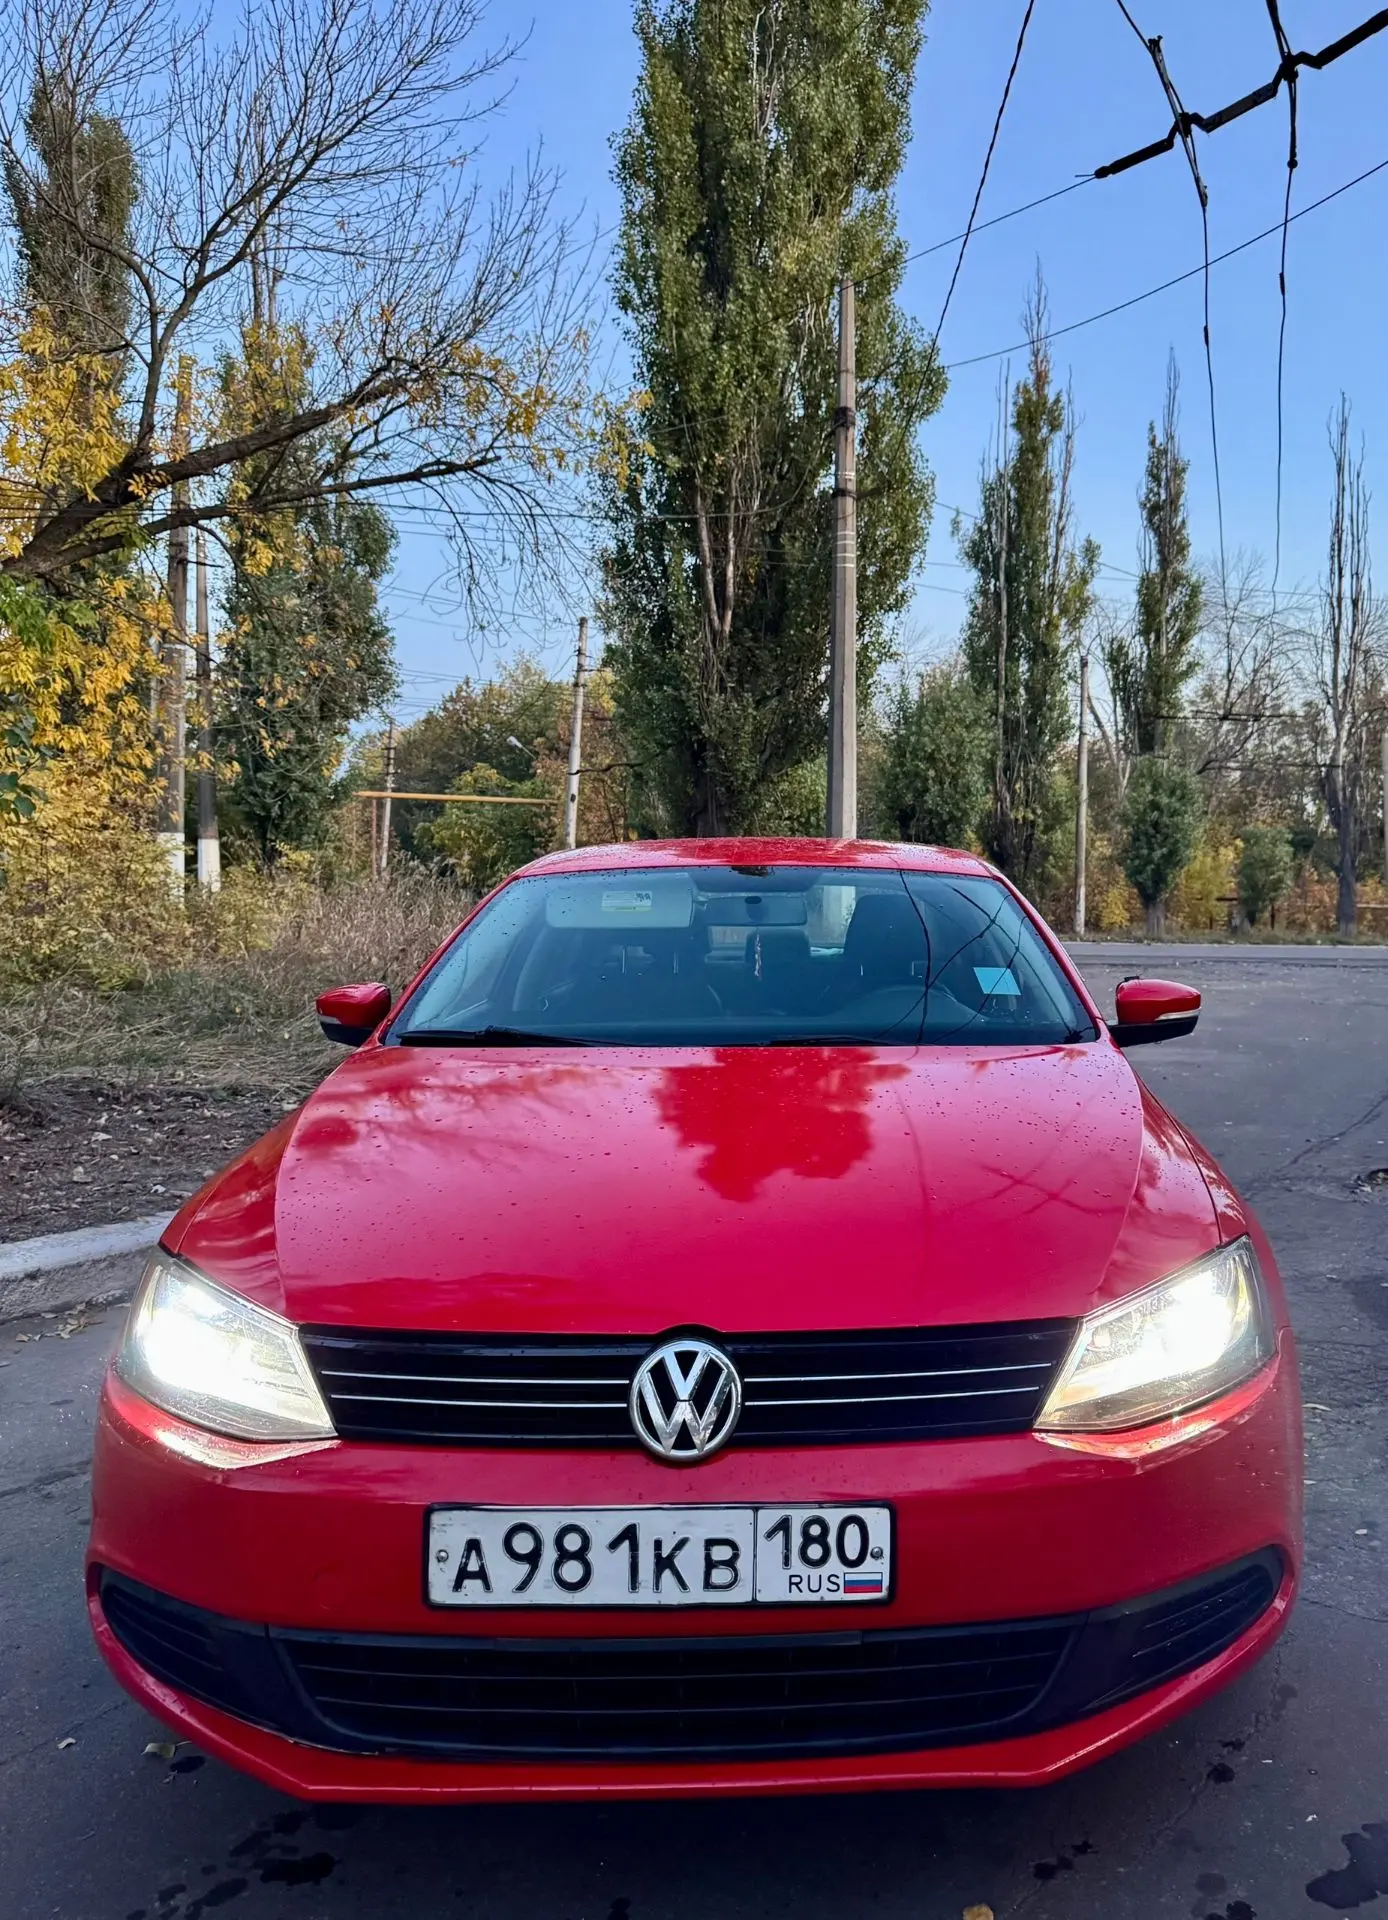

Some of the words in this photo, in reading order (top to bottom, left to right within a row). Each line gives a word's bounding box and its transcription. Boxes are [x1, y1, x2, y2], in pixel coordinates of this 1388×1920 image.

[637, 1345, 736, 1454] VW
[763, 1514, 870, 1569] 180
[788, 1573, 840, 1594] RUS
